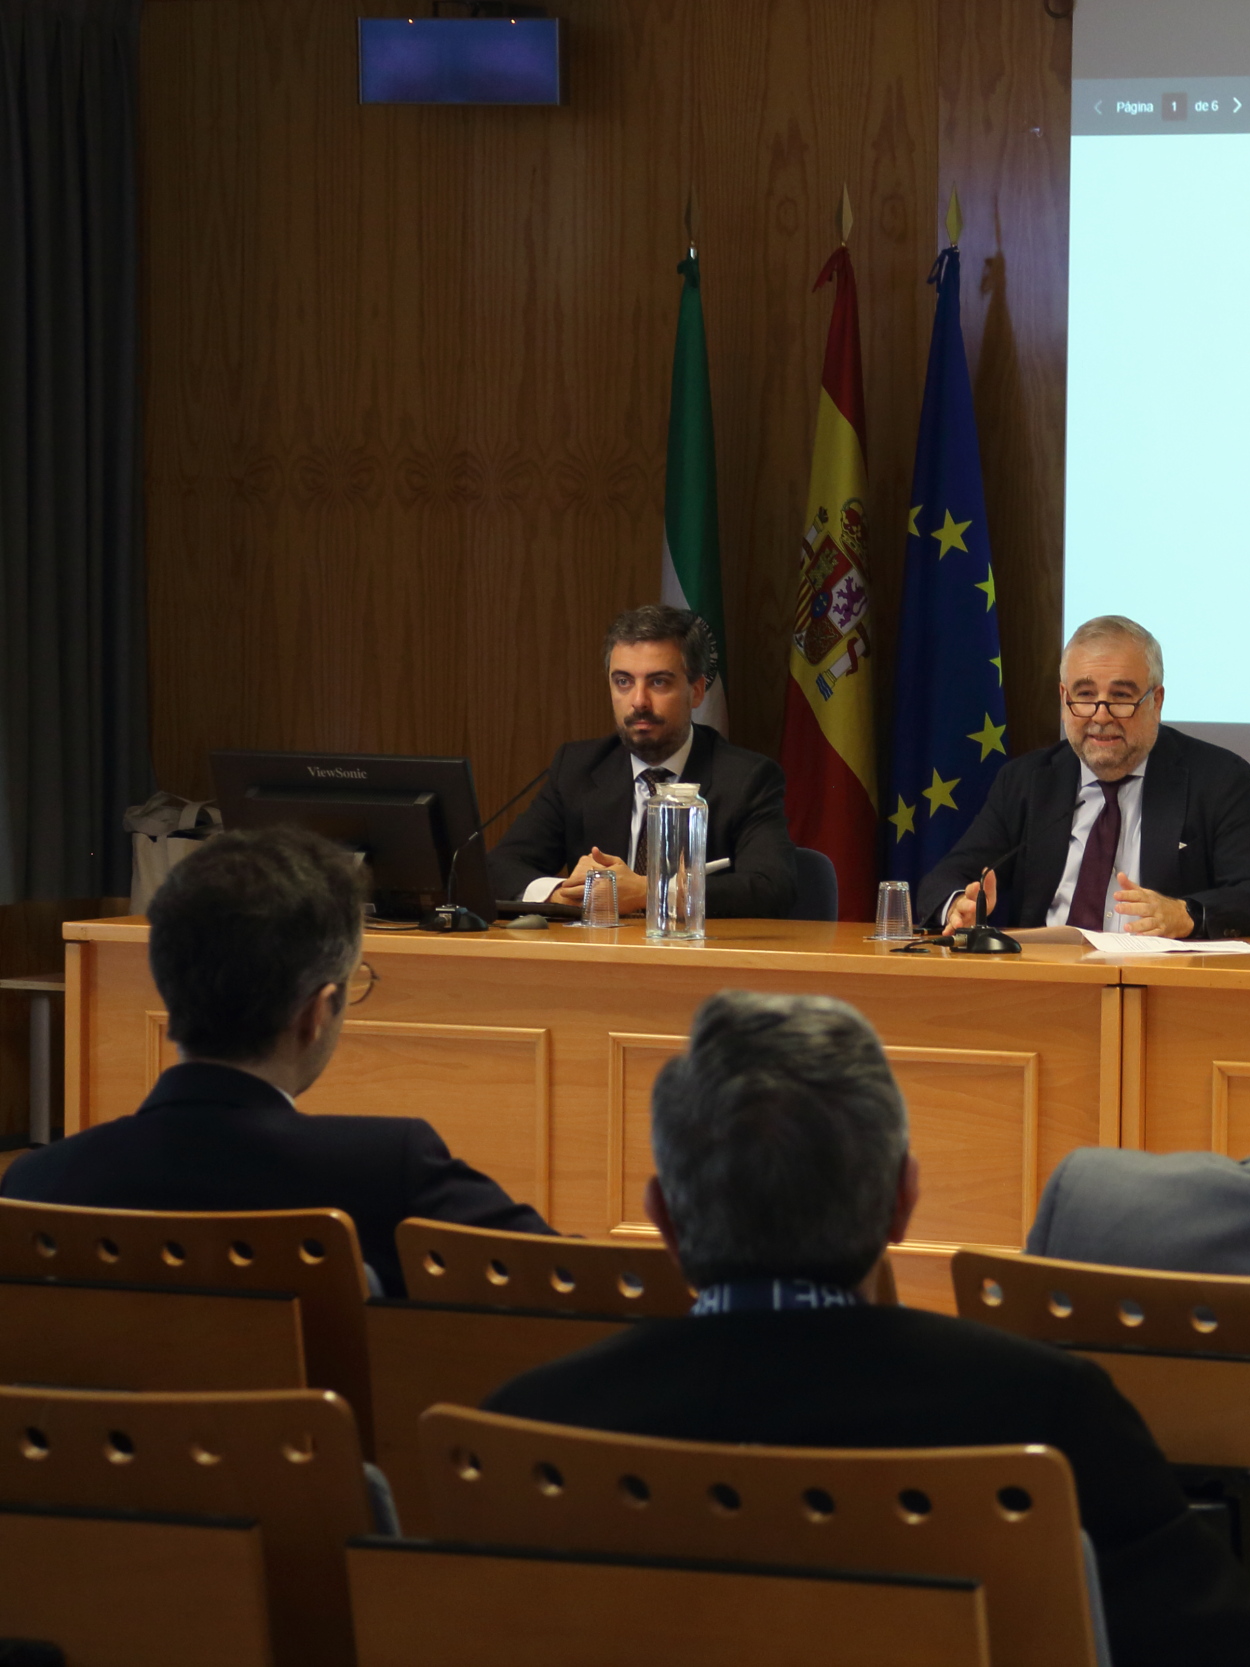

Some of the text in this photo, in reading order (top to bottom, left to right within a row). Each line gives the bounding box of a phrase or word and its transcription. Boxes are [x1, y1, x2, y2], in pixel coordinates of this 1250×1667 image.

[1116, 100, 1219, 115] Página 1 de 6
[307, 766, 368, 779] ViewSonic
